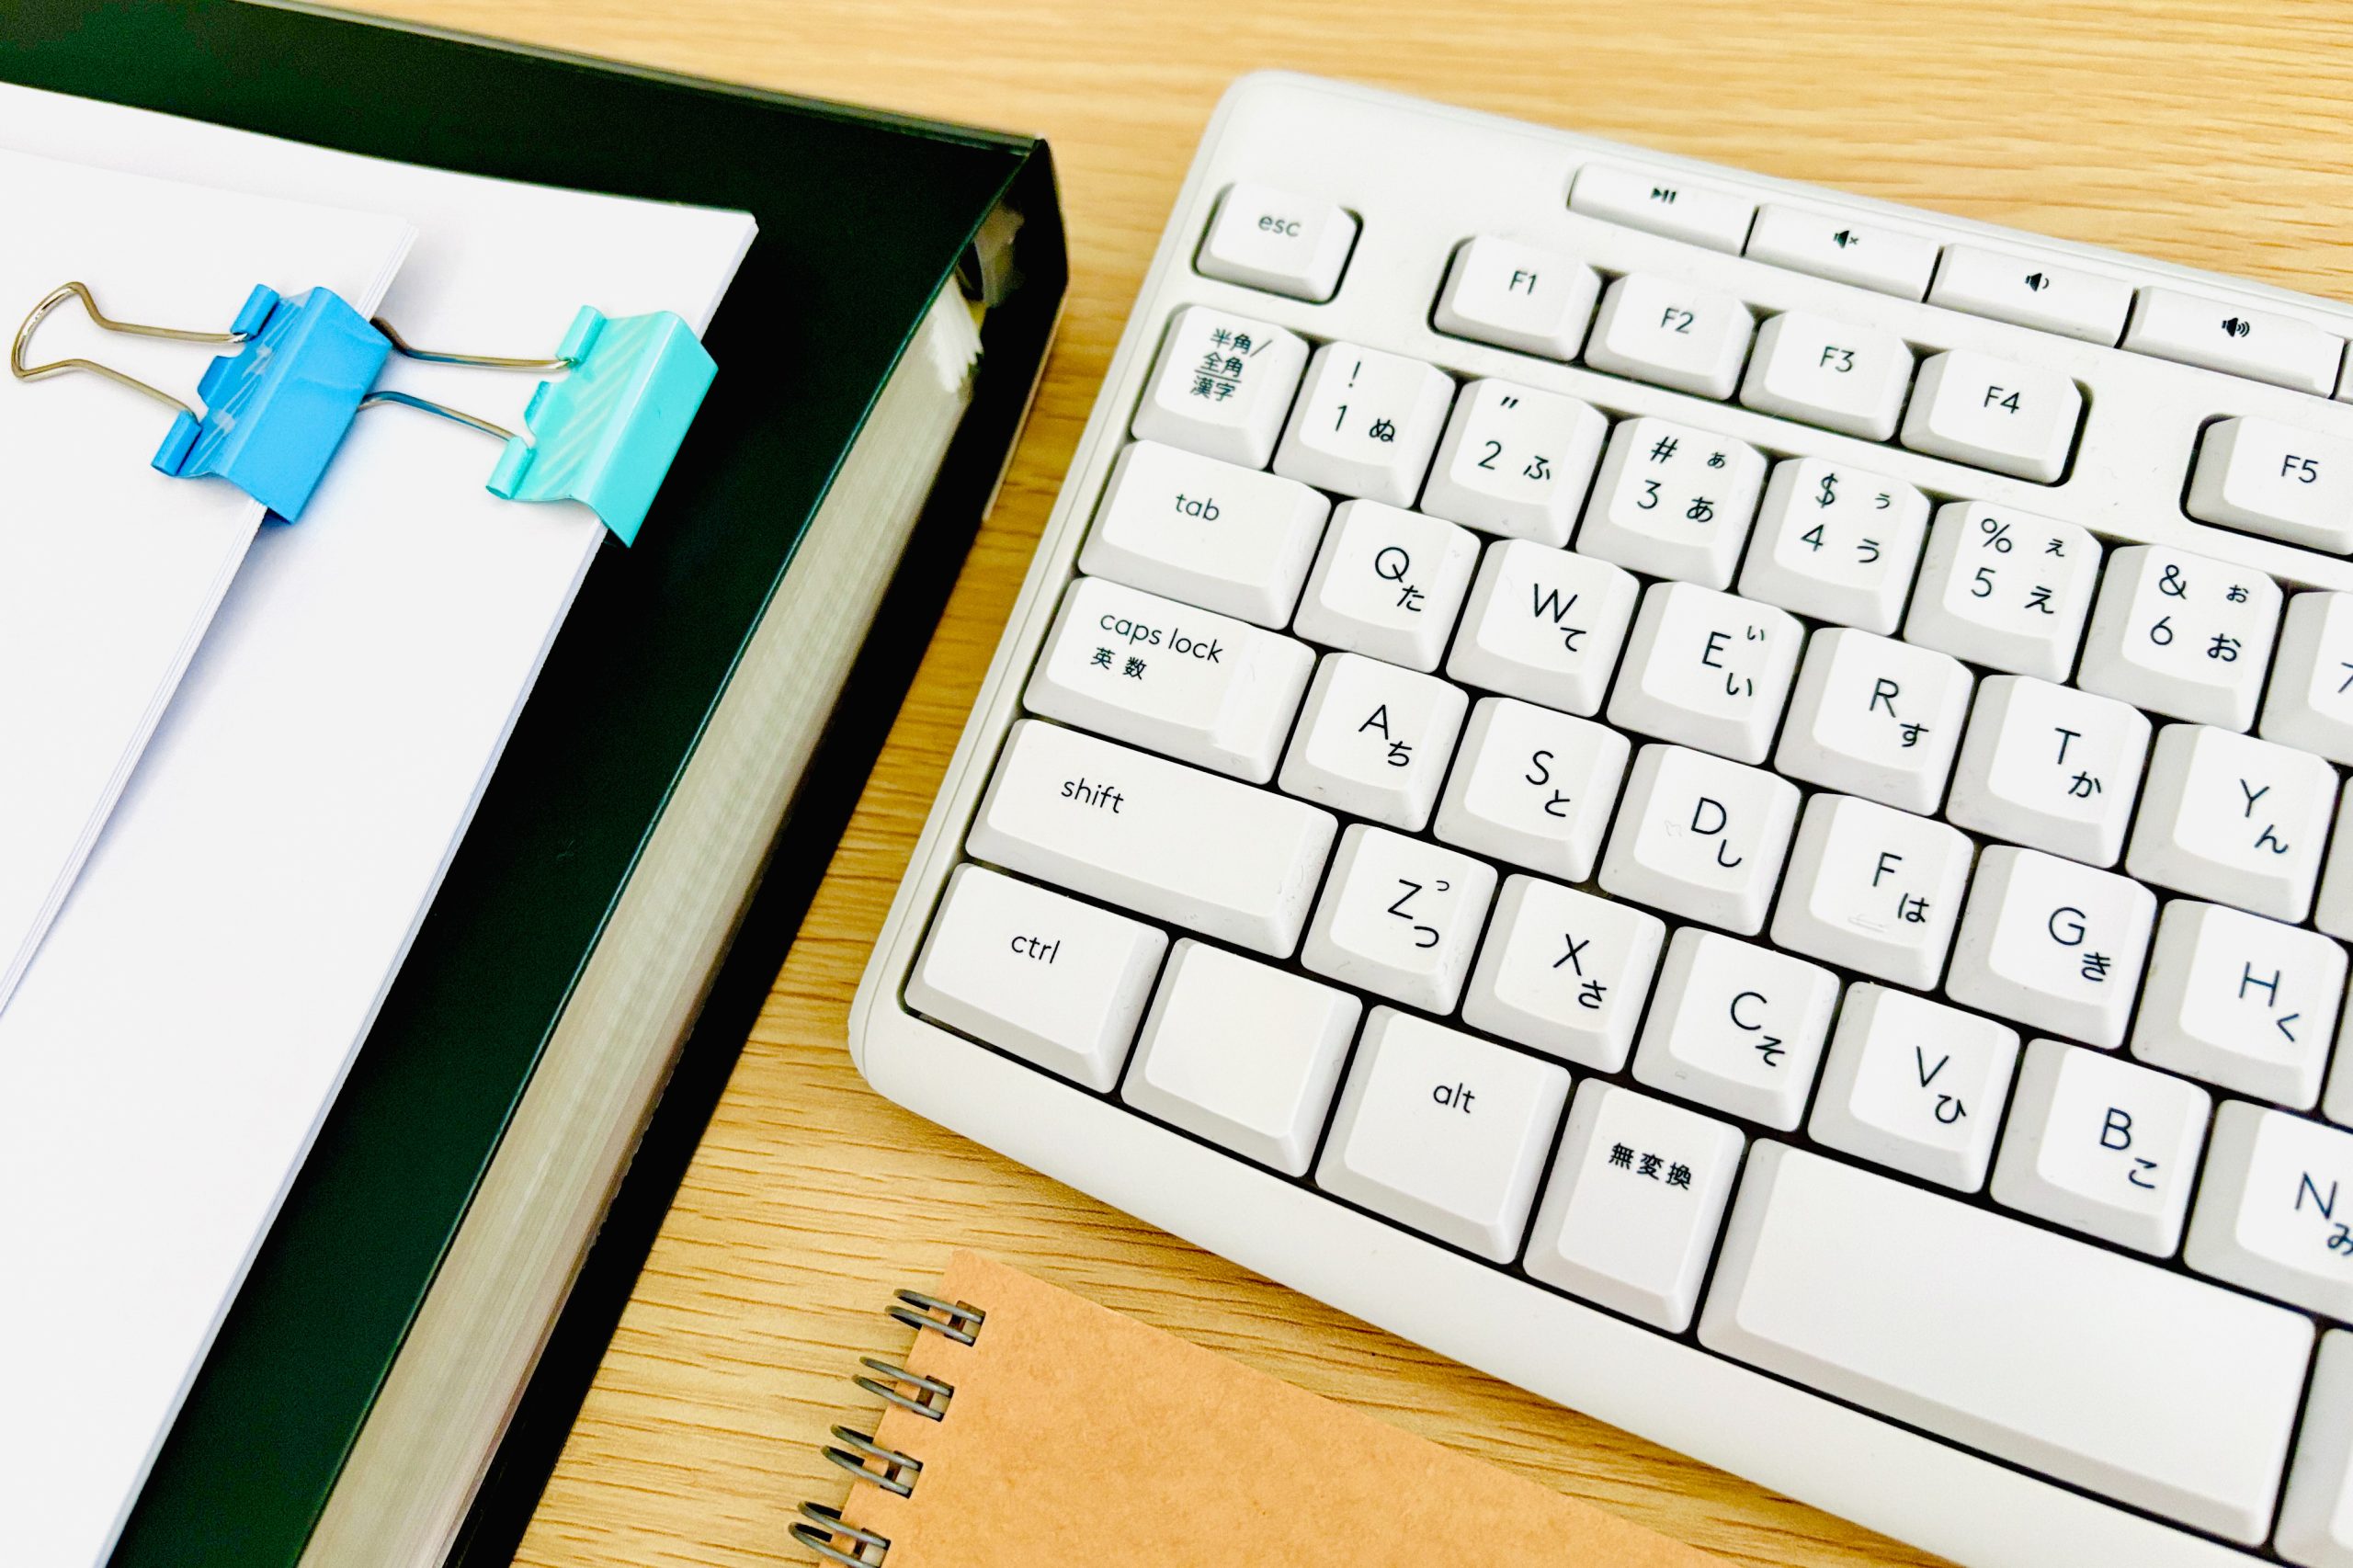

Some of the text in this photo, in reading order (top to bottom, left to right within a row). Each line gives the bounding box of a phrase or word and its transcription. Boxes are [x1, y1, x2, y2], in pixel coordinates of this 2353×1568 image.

[1257, 215, 1301, 237] esc
[1509, 270, 1537, 295] F1
[1661, 307, 1694, 335] F2
[1200, 351, 1244, 378] 全角
[1347, 360, 1361, 388] !
[1820, 346, 1855, 373] F3
[1189, 374, 1236, 402] 漢字
[1984, 385, 2020, 415] F4
[1335, 404, 1396, 443] 1 ぬ
[1477, 440, 1551, 481] 2 ふ
[1650, 436, 1679, 464] #
[2280, 454, 2319, 484] F5
[1176, 494, 1220, 521] tab
[1636, 479, 1714, 523] 3 あ
[1815, 472, 1838, 508] $
[1801, 524, 1880, 563] 4 う
[1981, 517, 2013, 554] %
[1374, 546, 1410, 584] Q
[2158, 563, 2187, 600] &
[1396, 585, 1426, 612] た
[1533, 583, 1578, 624] W
[1971, 566, 2054, 615] 5 え
[1100, 614, 1223, 664] caps lock
[1559, 626, 1587, 653] て
[1701, 631, 1733, 669] E
[2149, 616, 2242, 663] 6 お
[1725, 672, 1753, 698] い
[1869, 677, 1900, 719] R
[1358, 703, 1389, 741] A
[1899, 722, 1930, 748] す
[1387, 740, 1413, 767] ち
[2054, 727, 2082, 766] T
[1525, 750, 1554, 786] S
[2067, 770, 2102, 799] か
[1061, 777, 1124, 814] shift
[1544, 789, 1571, 818] と
[2240, 778, 2270, 818] Y
[1690, 796, 1727, 835] D
[1717, 838, 1743, 869] し
[2254, 824, 2290, 855] ん
[1872, 851, 1903, 888] F
[1387, 878, 1423, 920] Z
[1897, 892, 1930, 924] は
[2048, 906, 2086, 947] G
[1011, 936, 1061, 964] ctrl
[1552, 933, 1590, 977] X
[2081, 951, 2111, 983] き
[1577, 979, 1608, 1010] さ
[2238, 961, 2280, 1008] H
[1730, 991, 1768, 1031] C
[2276, 1013, 2300, 1043] く
[1755, 1035, 1786, 1068] そ
[1915, 1045, 1949, 1088] V
[1432, 1082, 1475, 1114] alt
[1934, 1094, 1967, 1125] ひ
[2099, 1107, 2132, 1152] B
[1608, 1142, 1692, 1191] 無変換
[2128, 1157, 2158, 1189] こ
[2295, 1172, 2337, 1221] N
